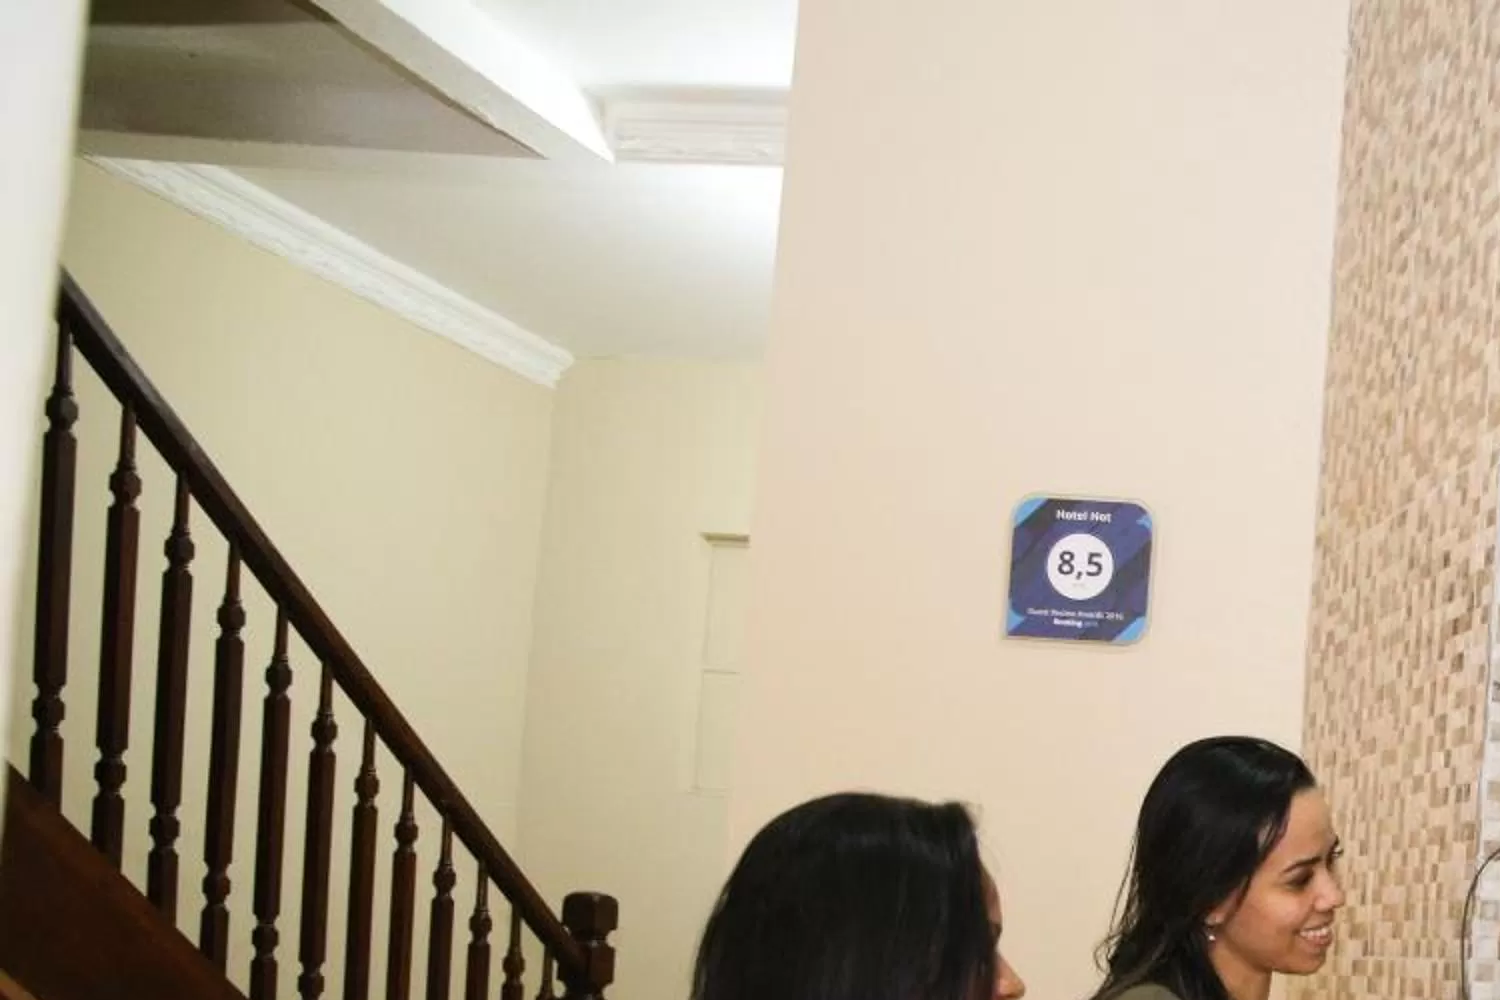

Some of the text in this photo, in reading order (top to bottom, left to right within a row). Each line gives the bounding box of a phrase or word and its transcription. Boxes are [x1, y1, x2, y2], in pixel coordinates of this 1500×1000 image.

[1056, 509, 1112, 524] Hotel Hot
[1057, 550, 1103, 580] 8,5
